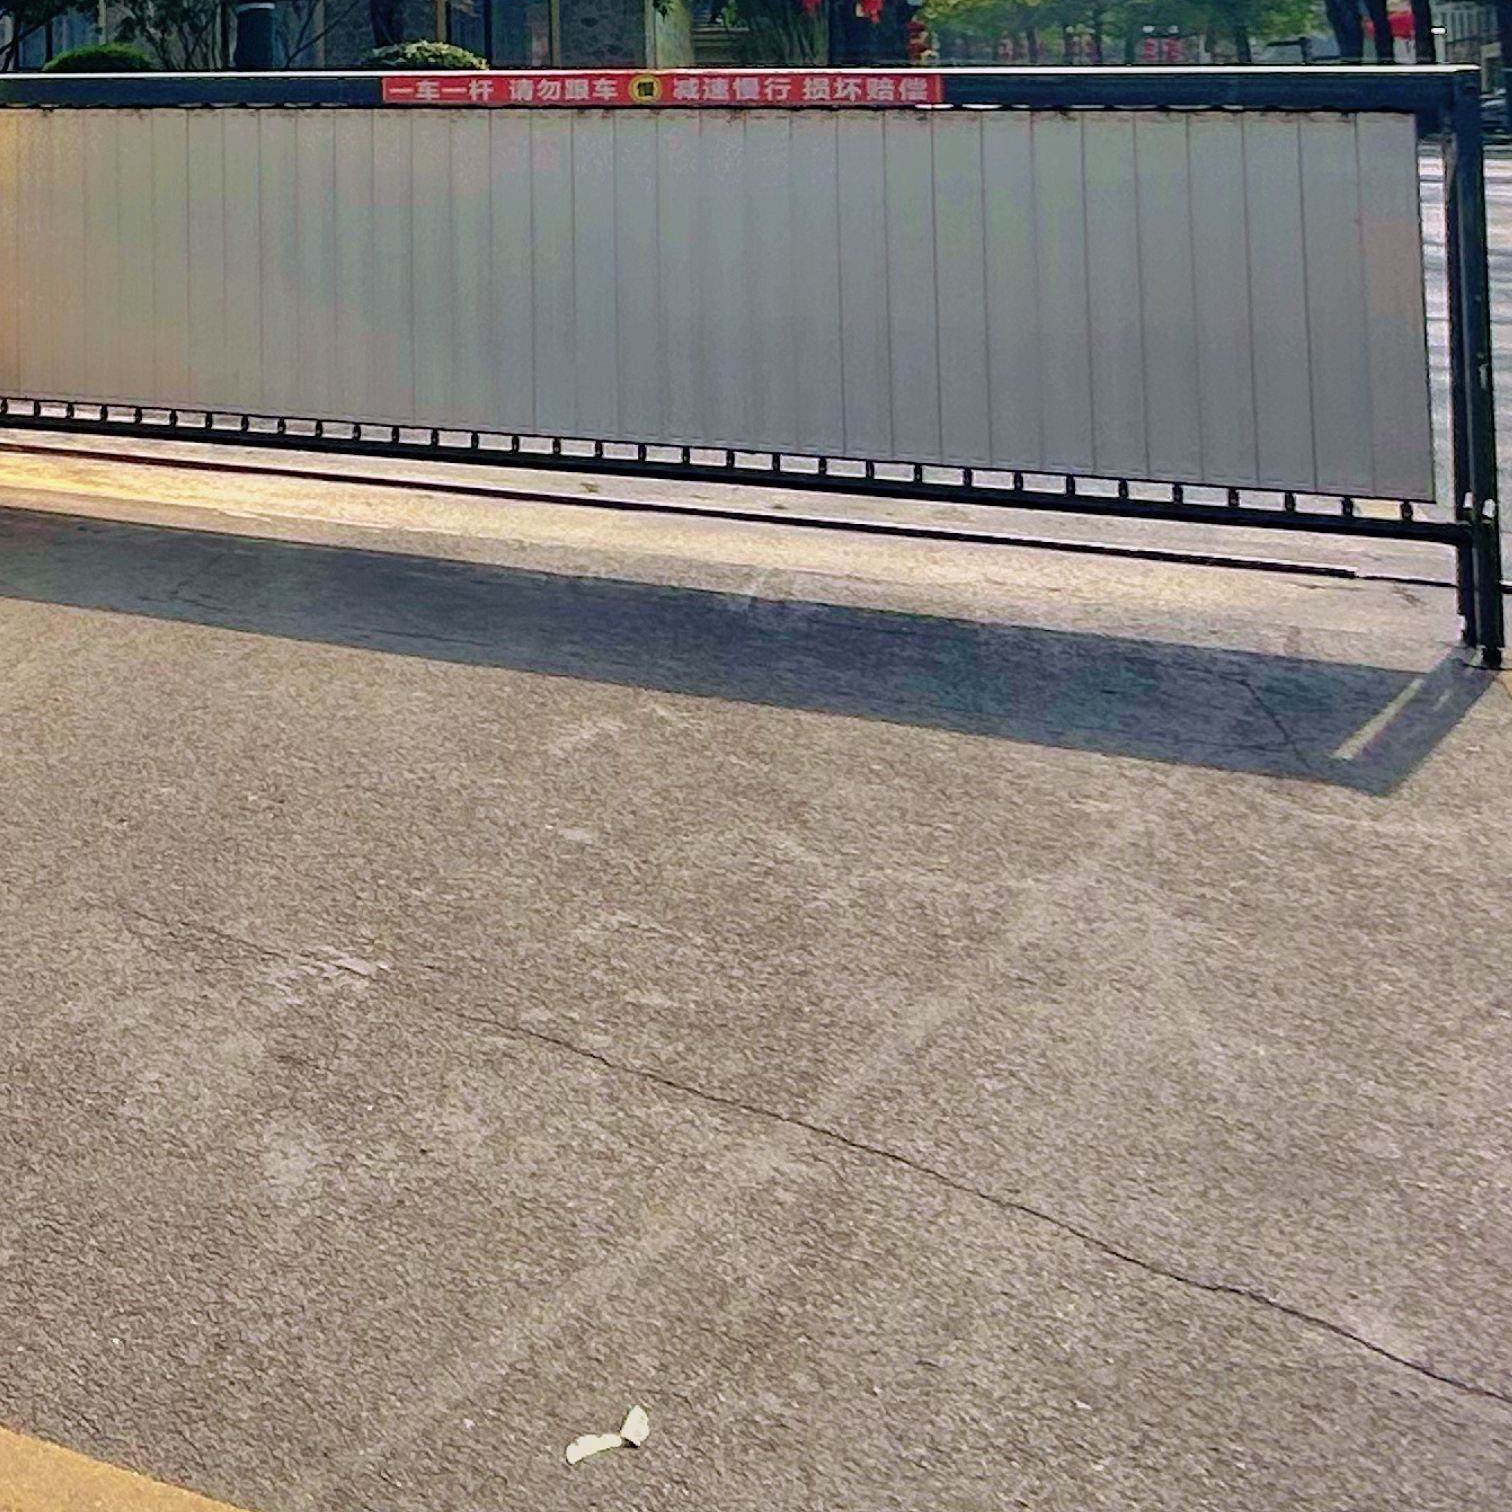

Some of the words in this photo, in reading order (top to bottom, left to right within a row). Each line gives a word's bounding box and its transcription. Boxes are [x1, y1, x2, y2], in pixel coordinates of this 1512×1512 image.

[388, 79, 494, 102] 一车一杆
[508, 78, 619, 101] 请勿跟车
[672, 77, 792, 101] 减速慢行
[802, 77, 929, 102] 损坏赔偿
